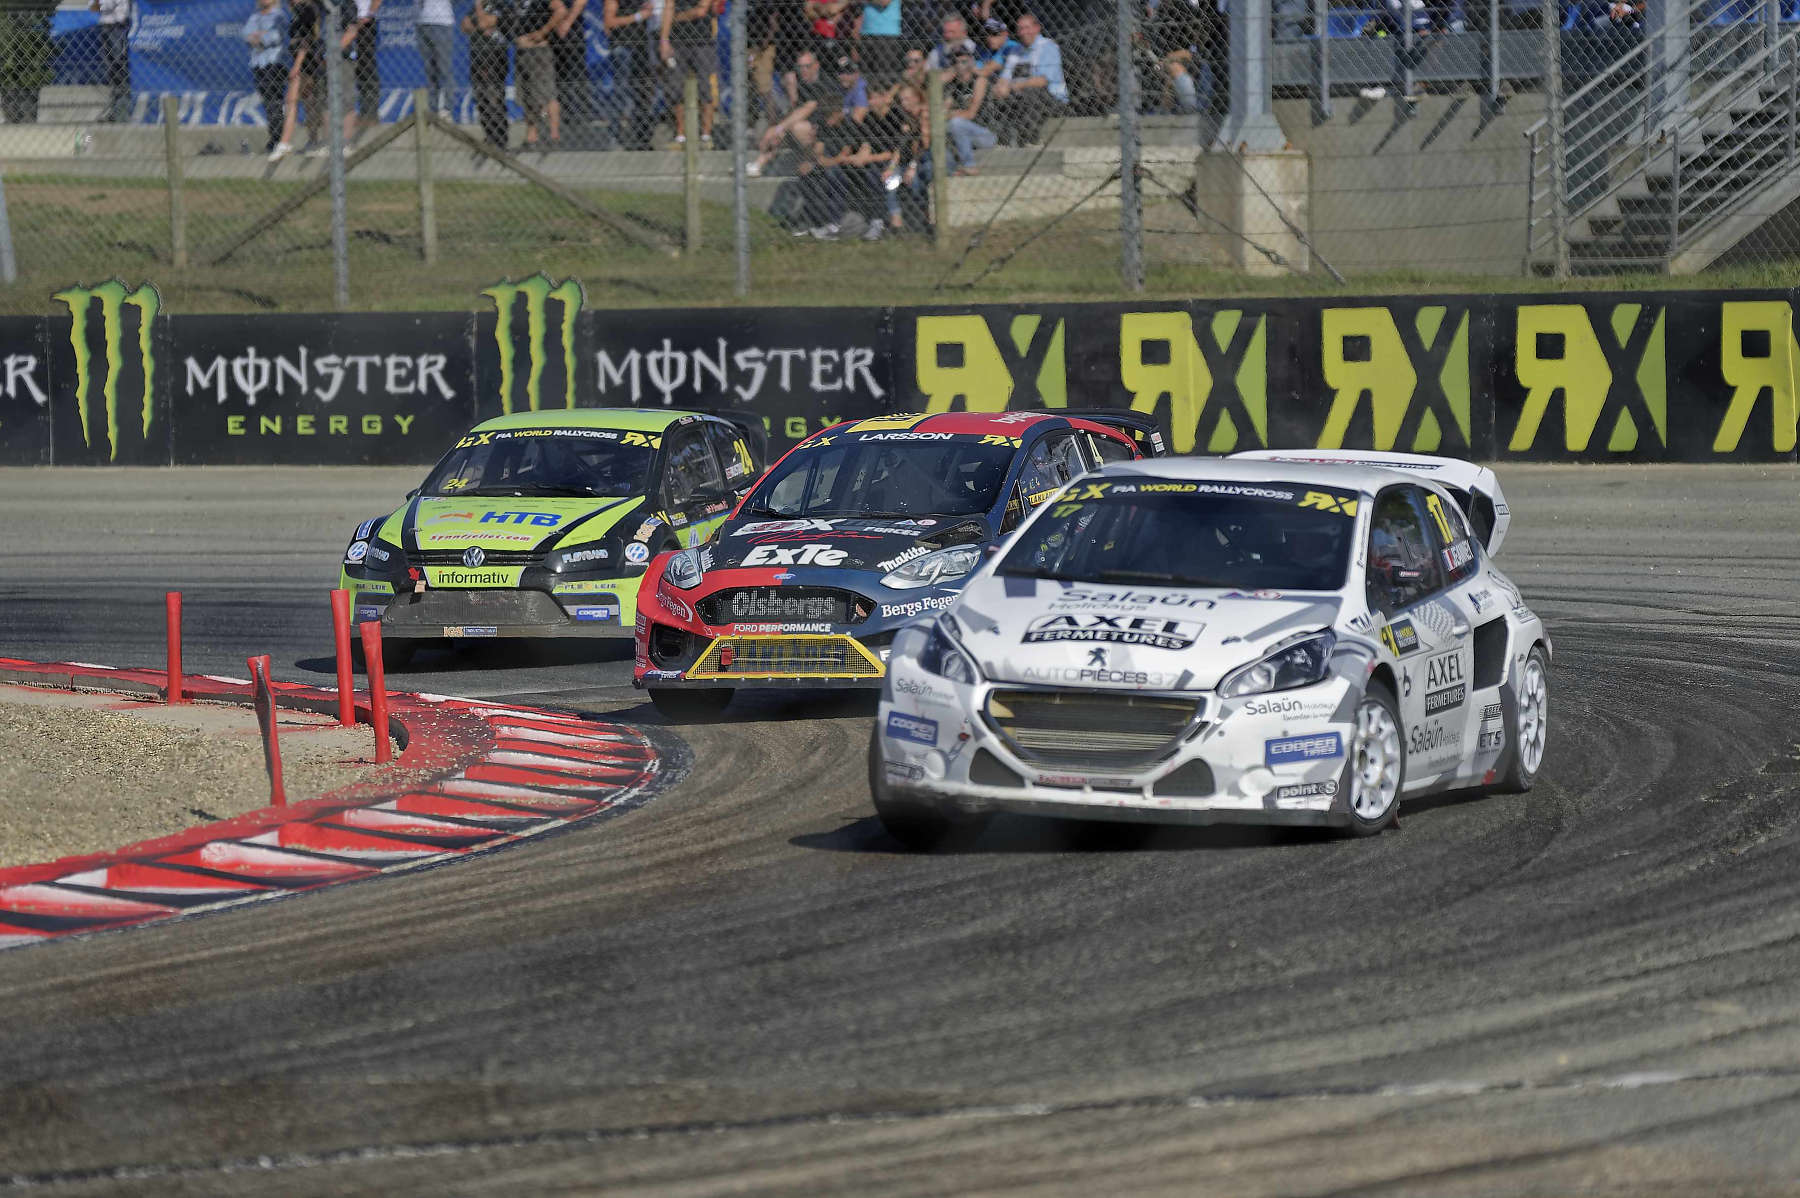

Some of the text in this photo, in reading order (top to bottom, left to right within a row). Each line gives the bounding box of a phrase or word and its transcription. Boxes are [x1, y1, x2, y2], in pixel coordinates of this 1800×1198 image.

[227, 414, 415, 434] ENERGY
[514, 430, 553, 438] WORLD
[552, 430, 619, 440] RALLYCROSS
[858, 433, 954, 441] LARSSON
[442, 478, 469, 490] 24
[1111, 484, 1137, 493] FIA
[1139, 484, 1197, 493] WORLD
[1197, 485, 1295, 500] RALLYCROSS
[479, 511, 563, 527] HTB
[438, 571, 509, 585] informativ
[734, 624, 832, 633] FORD PERFORMANCE
[1040, 615, 1189, 638] AXEL
[1029, 630, 1185, 649] FERMETURES
[1427, 653, 1464, 690] AXEL
[1244, 697, 1303, 715] Salaün
[1426, 687, 1464, 711] FERMETURES
[1271, 737, 1337, 754] COOPER
